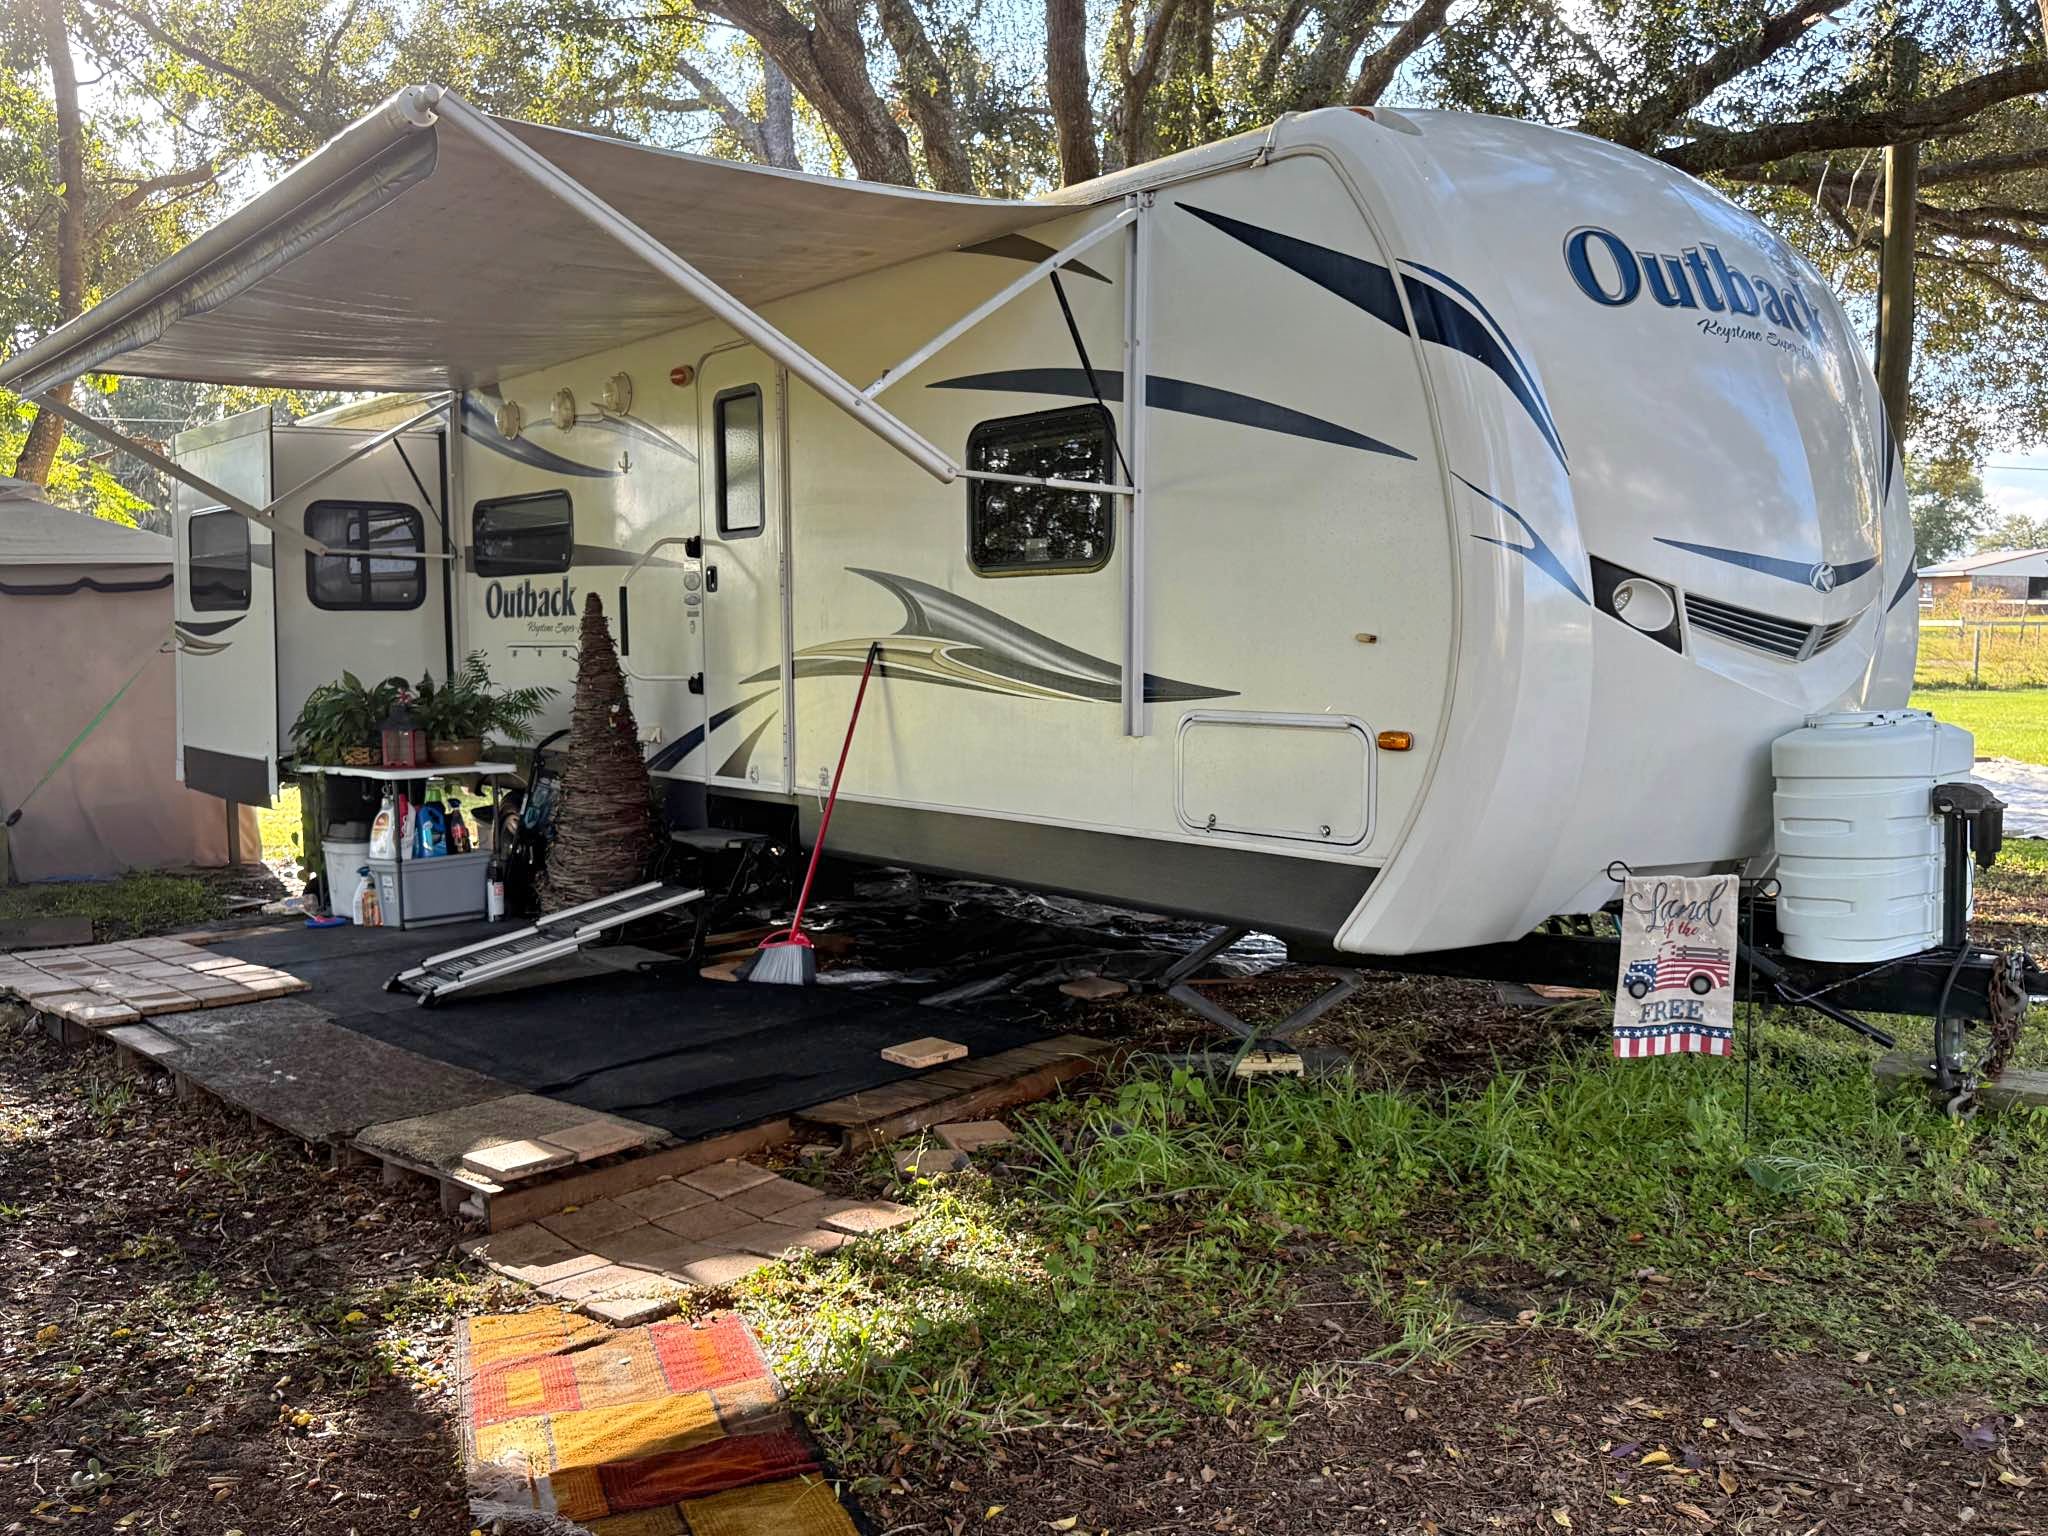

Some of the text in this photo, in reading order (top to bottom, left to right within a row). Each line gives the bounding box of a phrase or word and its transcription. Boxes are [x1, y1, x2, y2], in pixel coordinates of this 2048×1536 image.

[1563, 225, 1826, 343] Outback
[1698, 319, 1762, 343] Keystone
[486, 576, 577, 619] Outback
[1630, 881, 1728, 933] Land
[1678, 921, 1698, 937] the
[1638, 999, 1704, 1023] FREE
